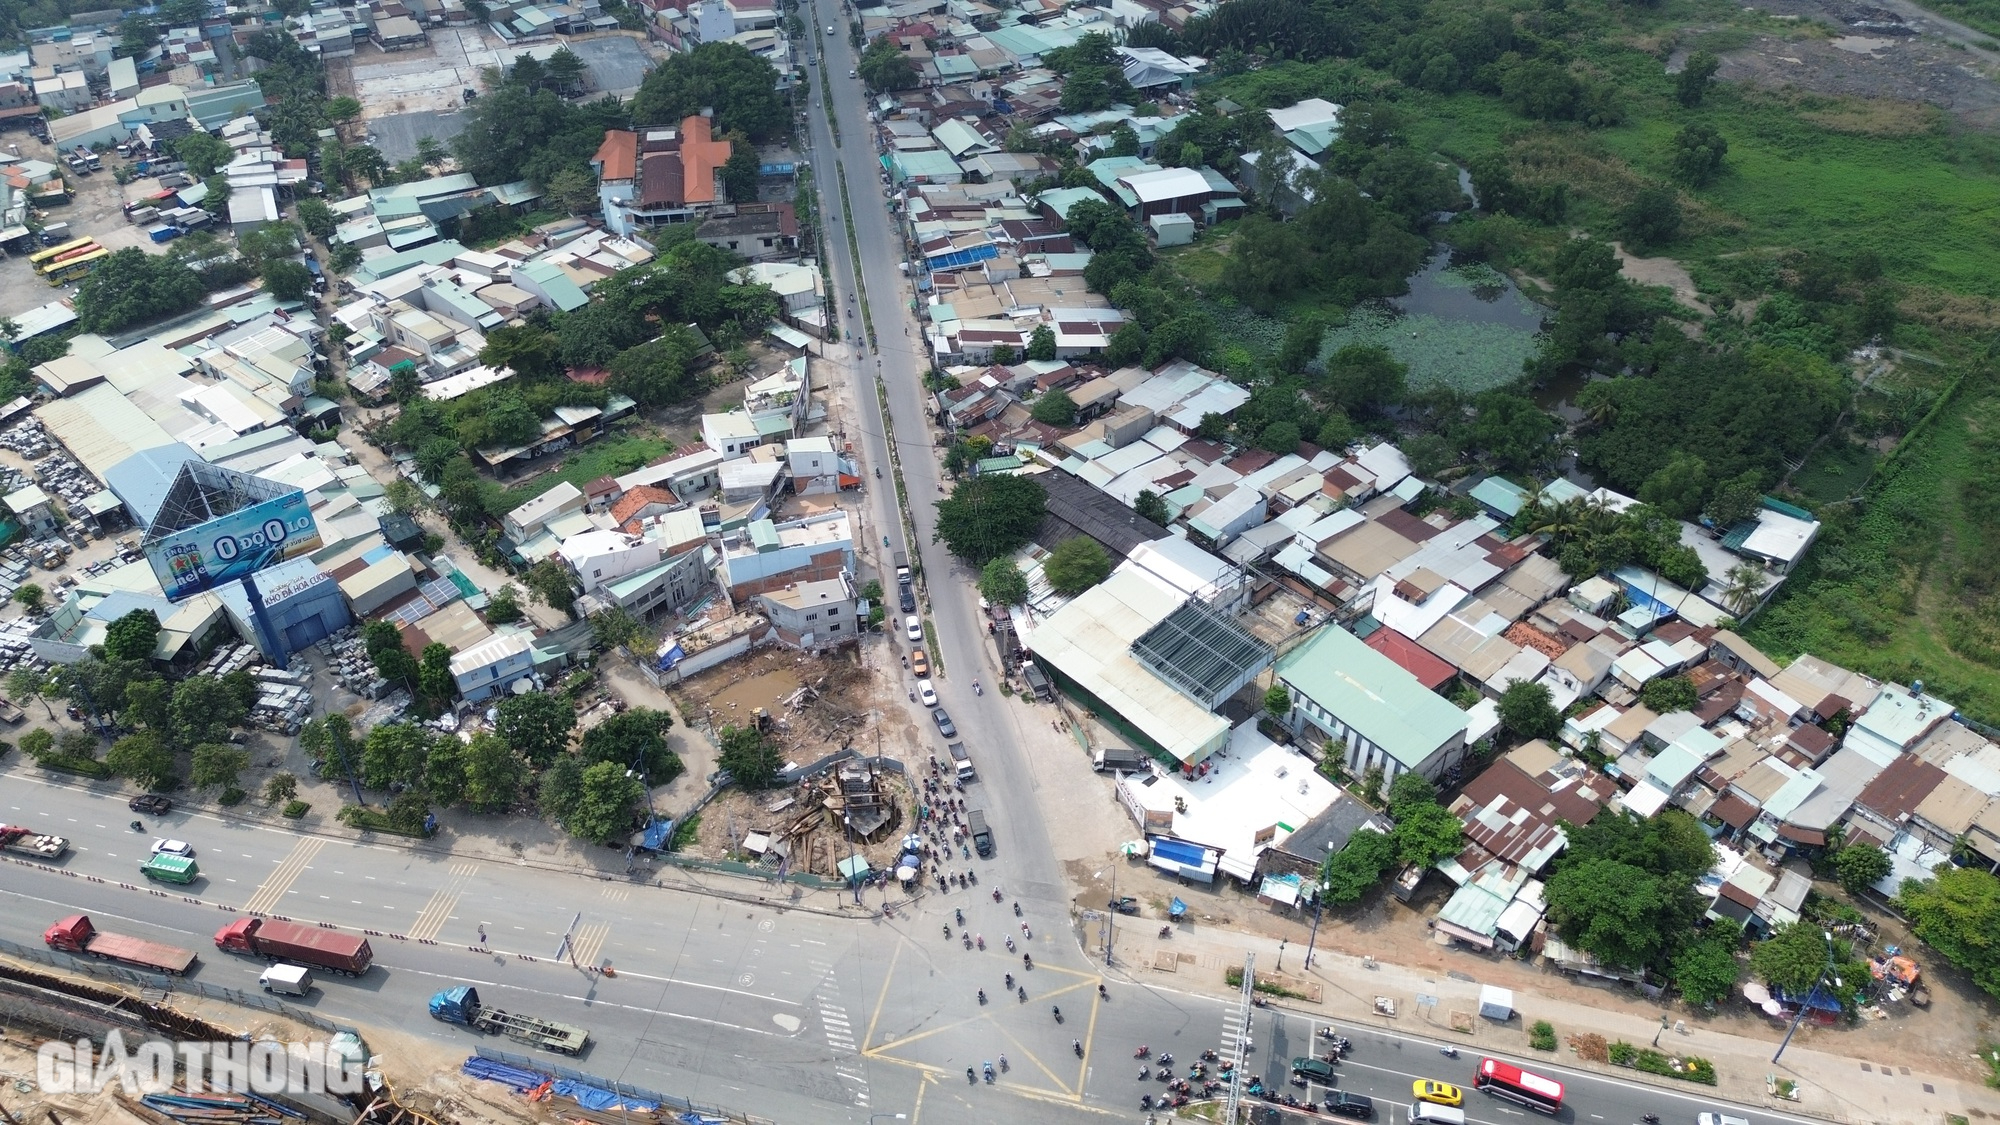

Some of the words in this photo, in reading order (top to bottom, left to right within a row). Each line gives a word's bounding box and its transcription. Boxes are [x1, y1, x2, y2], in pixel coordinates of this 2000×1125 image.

[239, 531, 265, 549] ĐỘ
[287, 516, 310, 533] LO
[264, 594, 281, 606] KHO
[281, 586, 293, 598] ĐÁ
[293, 580, 309, 593] HOA
